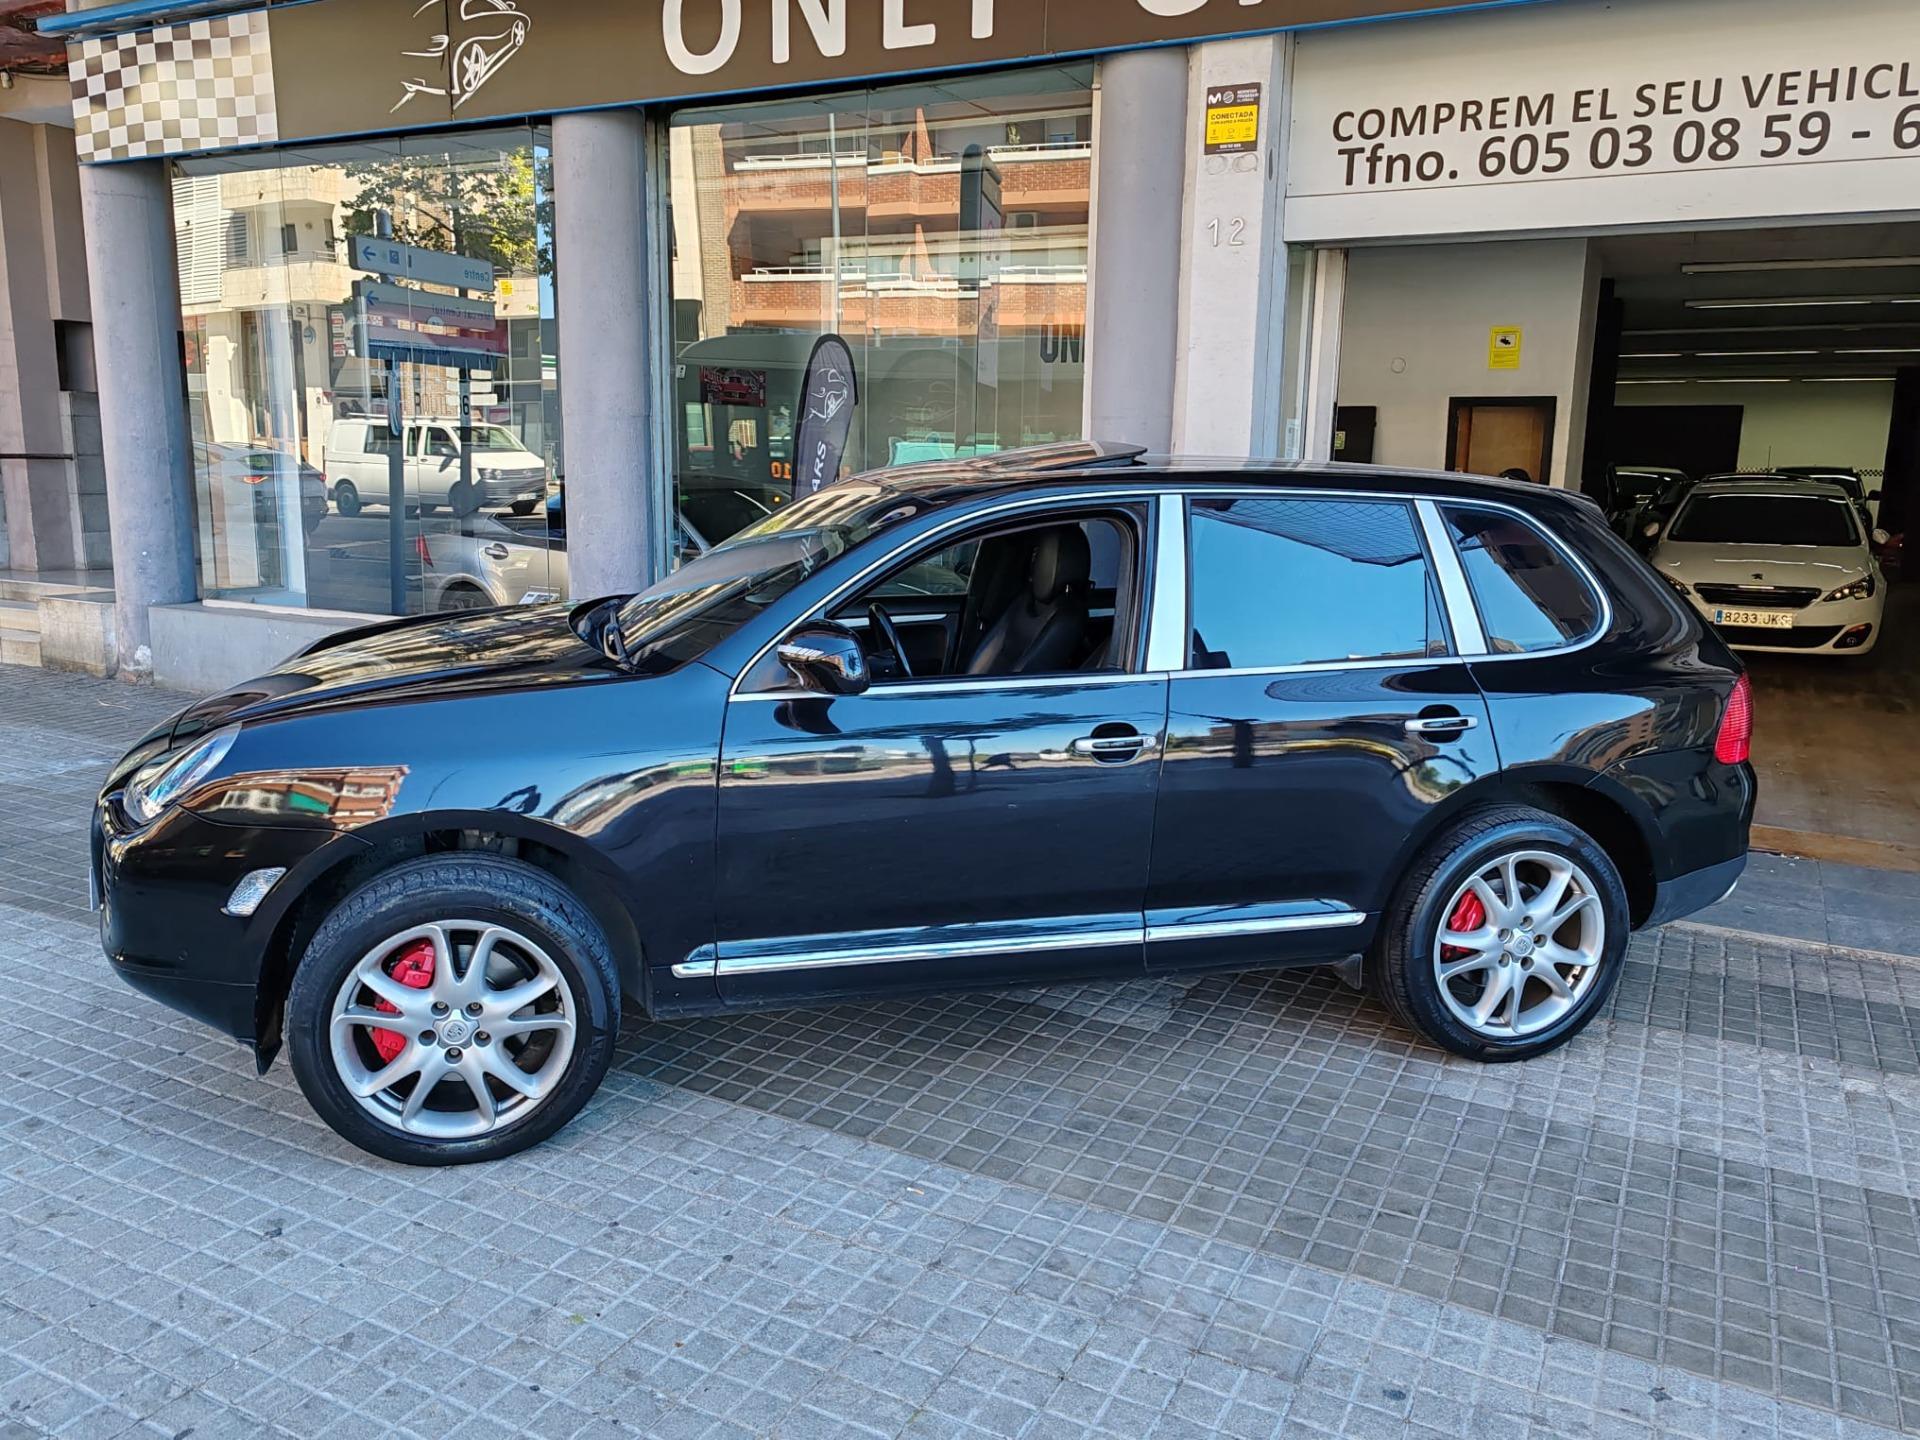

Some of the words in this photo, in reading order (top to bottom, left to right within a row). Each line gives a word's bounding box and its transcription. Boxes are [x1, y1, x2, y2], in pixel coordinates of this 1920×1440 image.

[1210, 111, 1254, 121] CONECTADA
[1333, 93, 1555, 142] COMPREM
[1572, 88, 1618, 122] EL
[1633, 78, 1722, 118] SEU
[1741, 62, 1920, 109] VEHICL
[1338, 143, 1458, 186] Tfno.
[1479, 131, 1570, 177] 605
[1589, 124, 1653, 170] 03
[1673, 117, 1741, 164] 08
[1760, 110, 1831, 158] 59
[1207, 217, 1245, 247] 12
[811, 440, 827, 492] ARS
[1724, 611, 1758, 624] 8233
